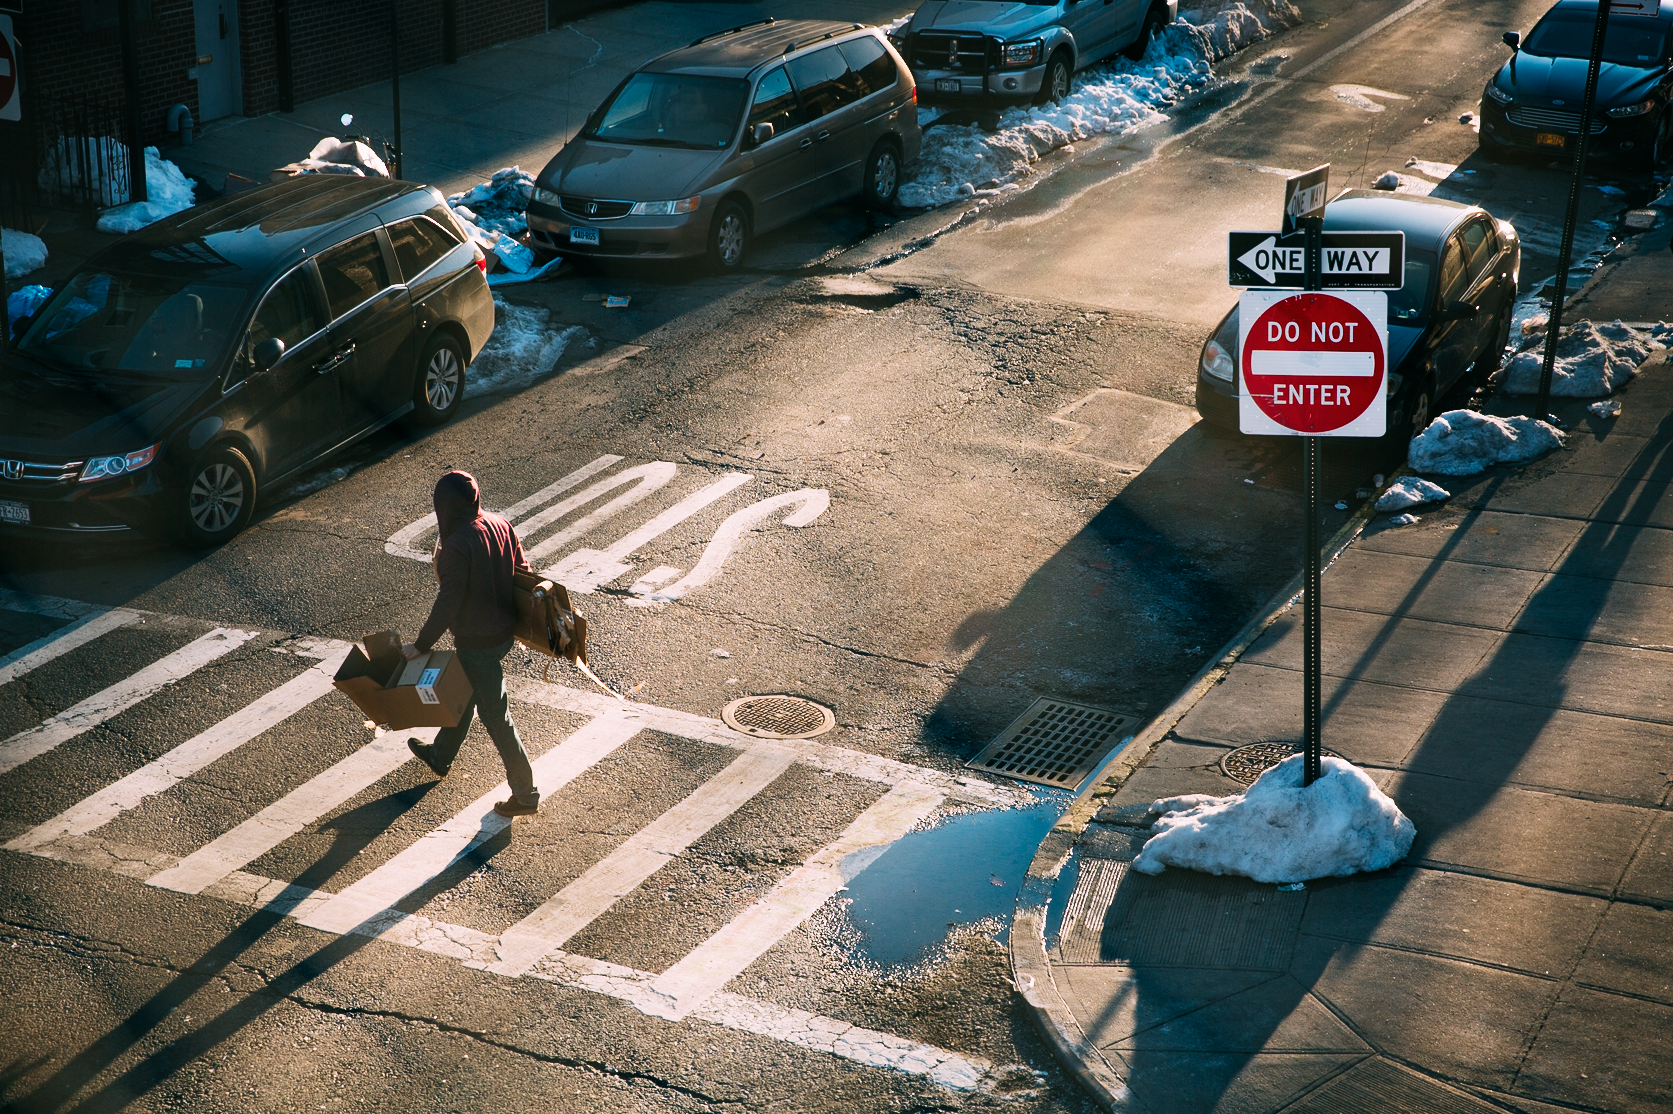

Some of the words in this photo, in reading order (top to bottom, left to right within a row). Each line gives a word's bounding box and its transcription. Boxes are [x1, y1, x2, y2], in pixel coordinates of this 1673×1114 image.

[1290, 192, 1305, 216] ONE
[1310, 184, 1324, 210] WAY
[1255, 249, 1302, 271] ONE
[1327, 250, 1380, 272] WAY
[1267, 321, 1300, 343] DO
[1311, 321, 1359, 343] NOT
[1273, 383, 1351, 406] ENTER
[384, 453, 830, 606] STOP
